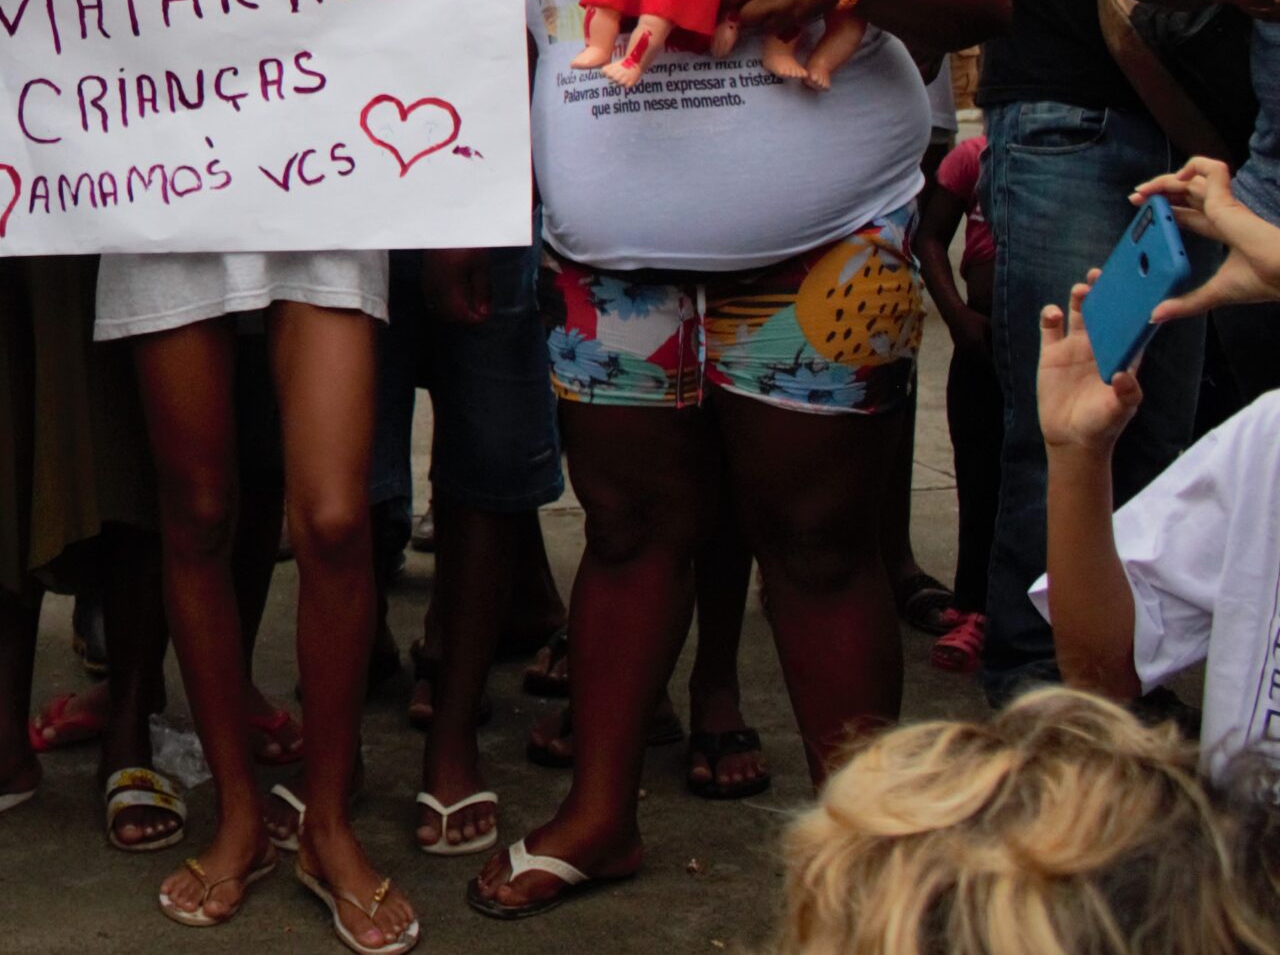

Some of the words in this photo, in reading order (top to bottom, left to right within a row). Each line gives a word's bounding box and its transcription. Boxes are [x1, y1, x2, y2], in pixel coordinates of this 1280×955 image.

[692, 60, 712, 72] em
[714, 59, 742, 71] meu
[18, 51, 327, 144] CRIANÇAS
[563, 84, 600, 104] Palavras
[624, 77, 663, 102] podem
[666, 75, 726, 95] expressar
[729, 76, 736, 88] a
[739, 72, 784, 89] tristeza
[591, 102, 611, 119] que
[612, 97, 641, 114] sinto
[643, 97, 678, 112] nesse
[681, 93, 746, 109] momento.
[259, 143, 356, 193] VCS
